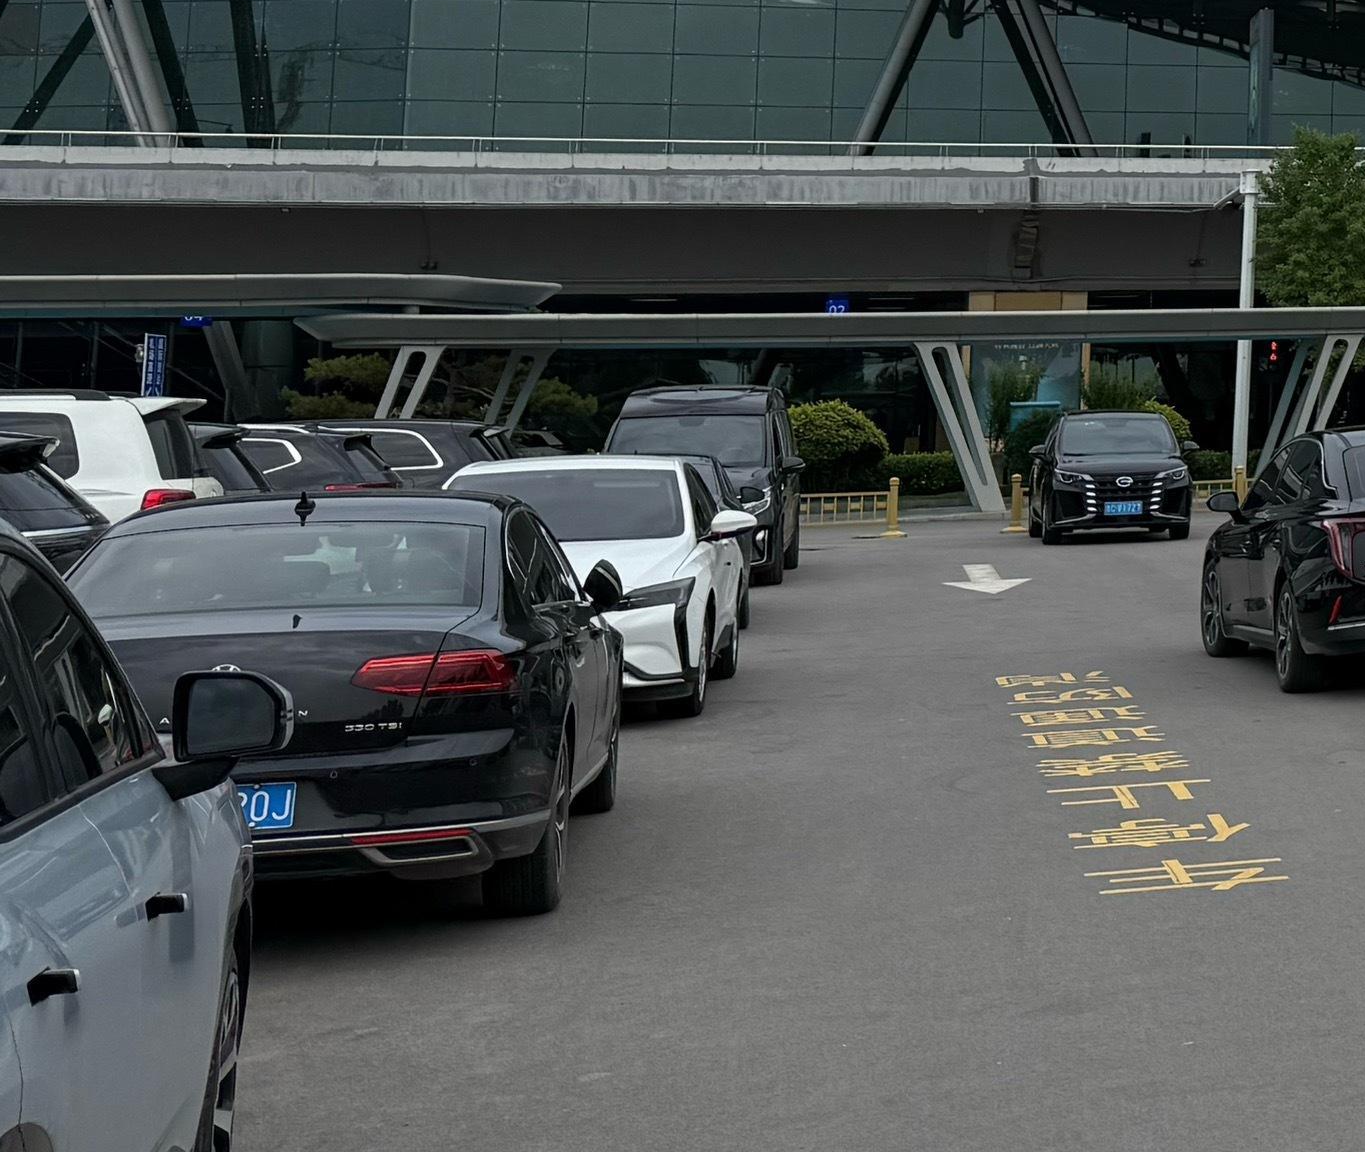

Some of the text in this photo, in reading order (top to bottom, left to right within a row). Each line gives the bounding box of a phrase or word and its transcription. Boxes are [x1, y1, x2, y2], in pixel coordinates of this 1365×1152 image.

[996, 670, 1291, 895] 消防通道禁止停车
